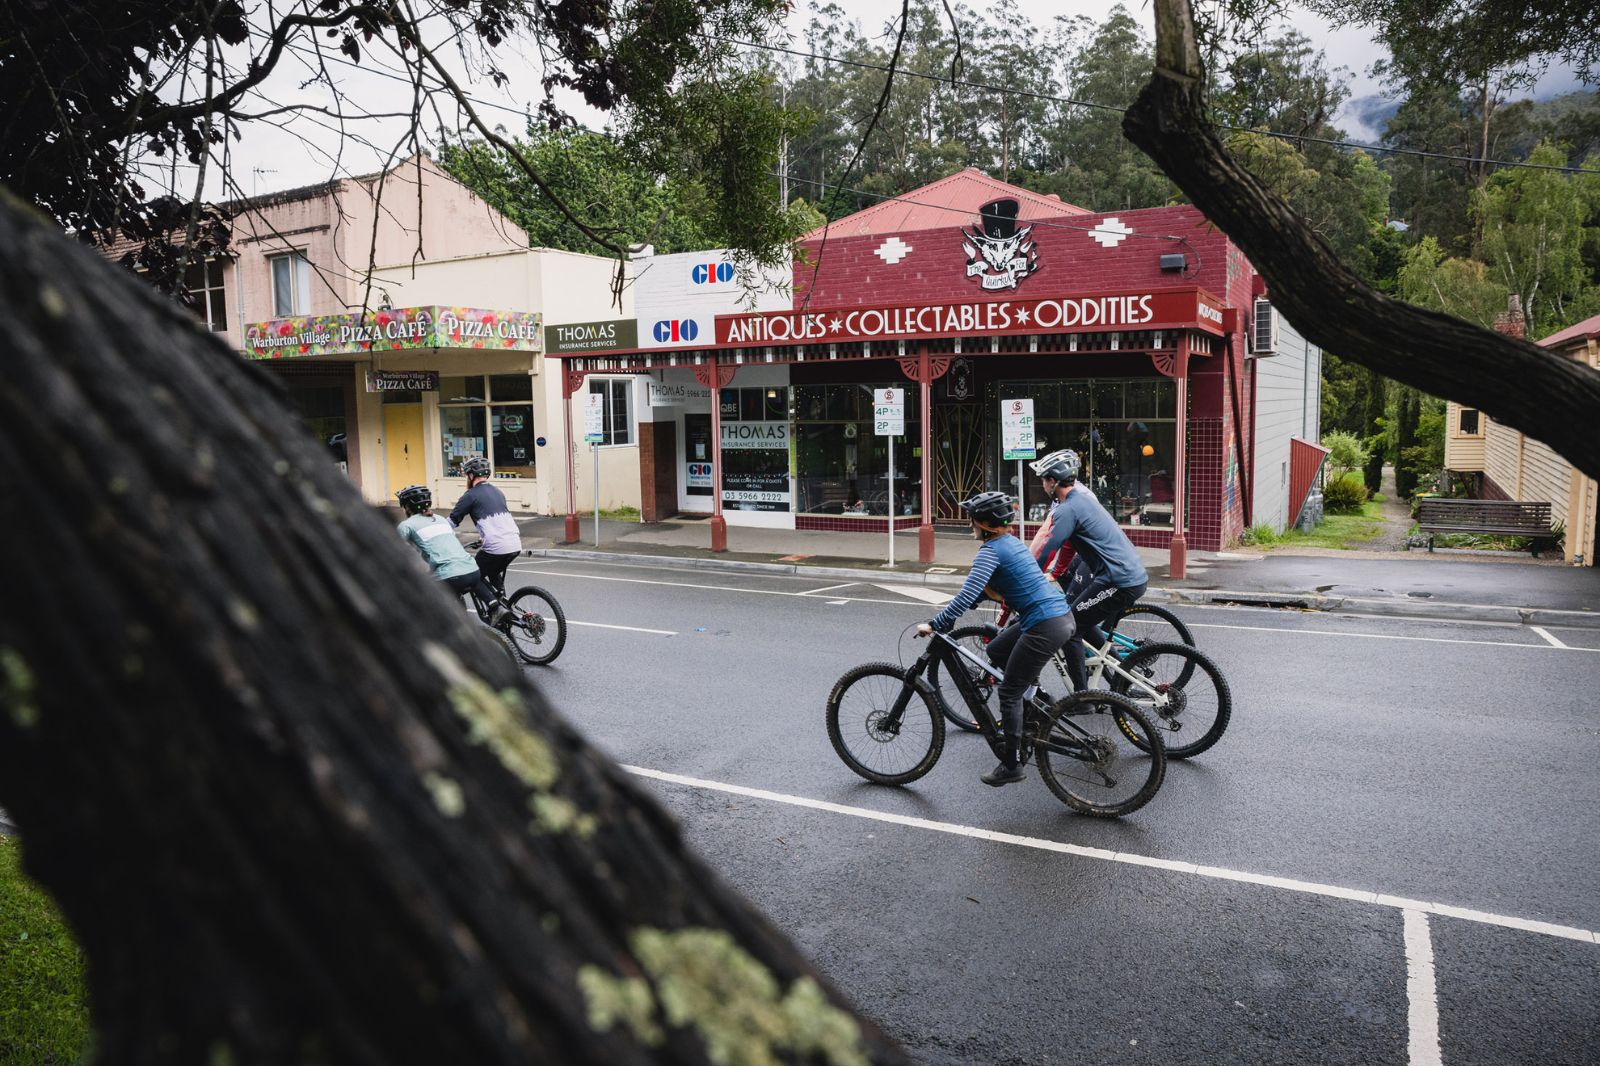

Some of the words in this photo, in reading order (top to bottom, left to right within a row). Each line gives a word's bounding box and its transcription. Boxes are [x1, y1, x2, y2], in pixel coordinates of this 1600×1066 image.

[692, 262, 733, 284] GIO
[727, 314, 827, 343] ANTIQUES
[845, 303, 1012, 336] COLLECTABLES
[1033, 295, 1154, 328] ODDITIES
[386, 316, 427, 339] CAFÉ
[447, 317, 494, 337] PIZZA
[497, 320, 535, 340] CAFÉ
[557, 324, 616, 341] THOMAS
[653, 319, 699, 342] GIO
[252, 335, 298, 348] Warburton
[299, 331, 331, 345] Village
[559, 342, 589, 350] INSURANCE
[590, 340, 617, 348] SERVICES
[376, 379, 406, 390] PIZZA
[407, 377, 433, 390] CAFÉ
[651, 385, 685, 396] THOMAS
[720, 403, 737, 413] QBE
[875, 407, 889, 416] 4P
[876, 421, 889, 430] 2P
[1019, 416, 1033, 425] 4P
[720, 425, 786, 440] THOMAS
[1019, 432, 1033, 442] 2P
[689, 464, 712, 476] GIO
[725, 491, 735, 500] 03
[738, 492, 758, 500] 5966
[761, 493, 782, 501] 2222
